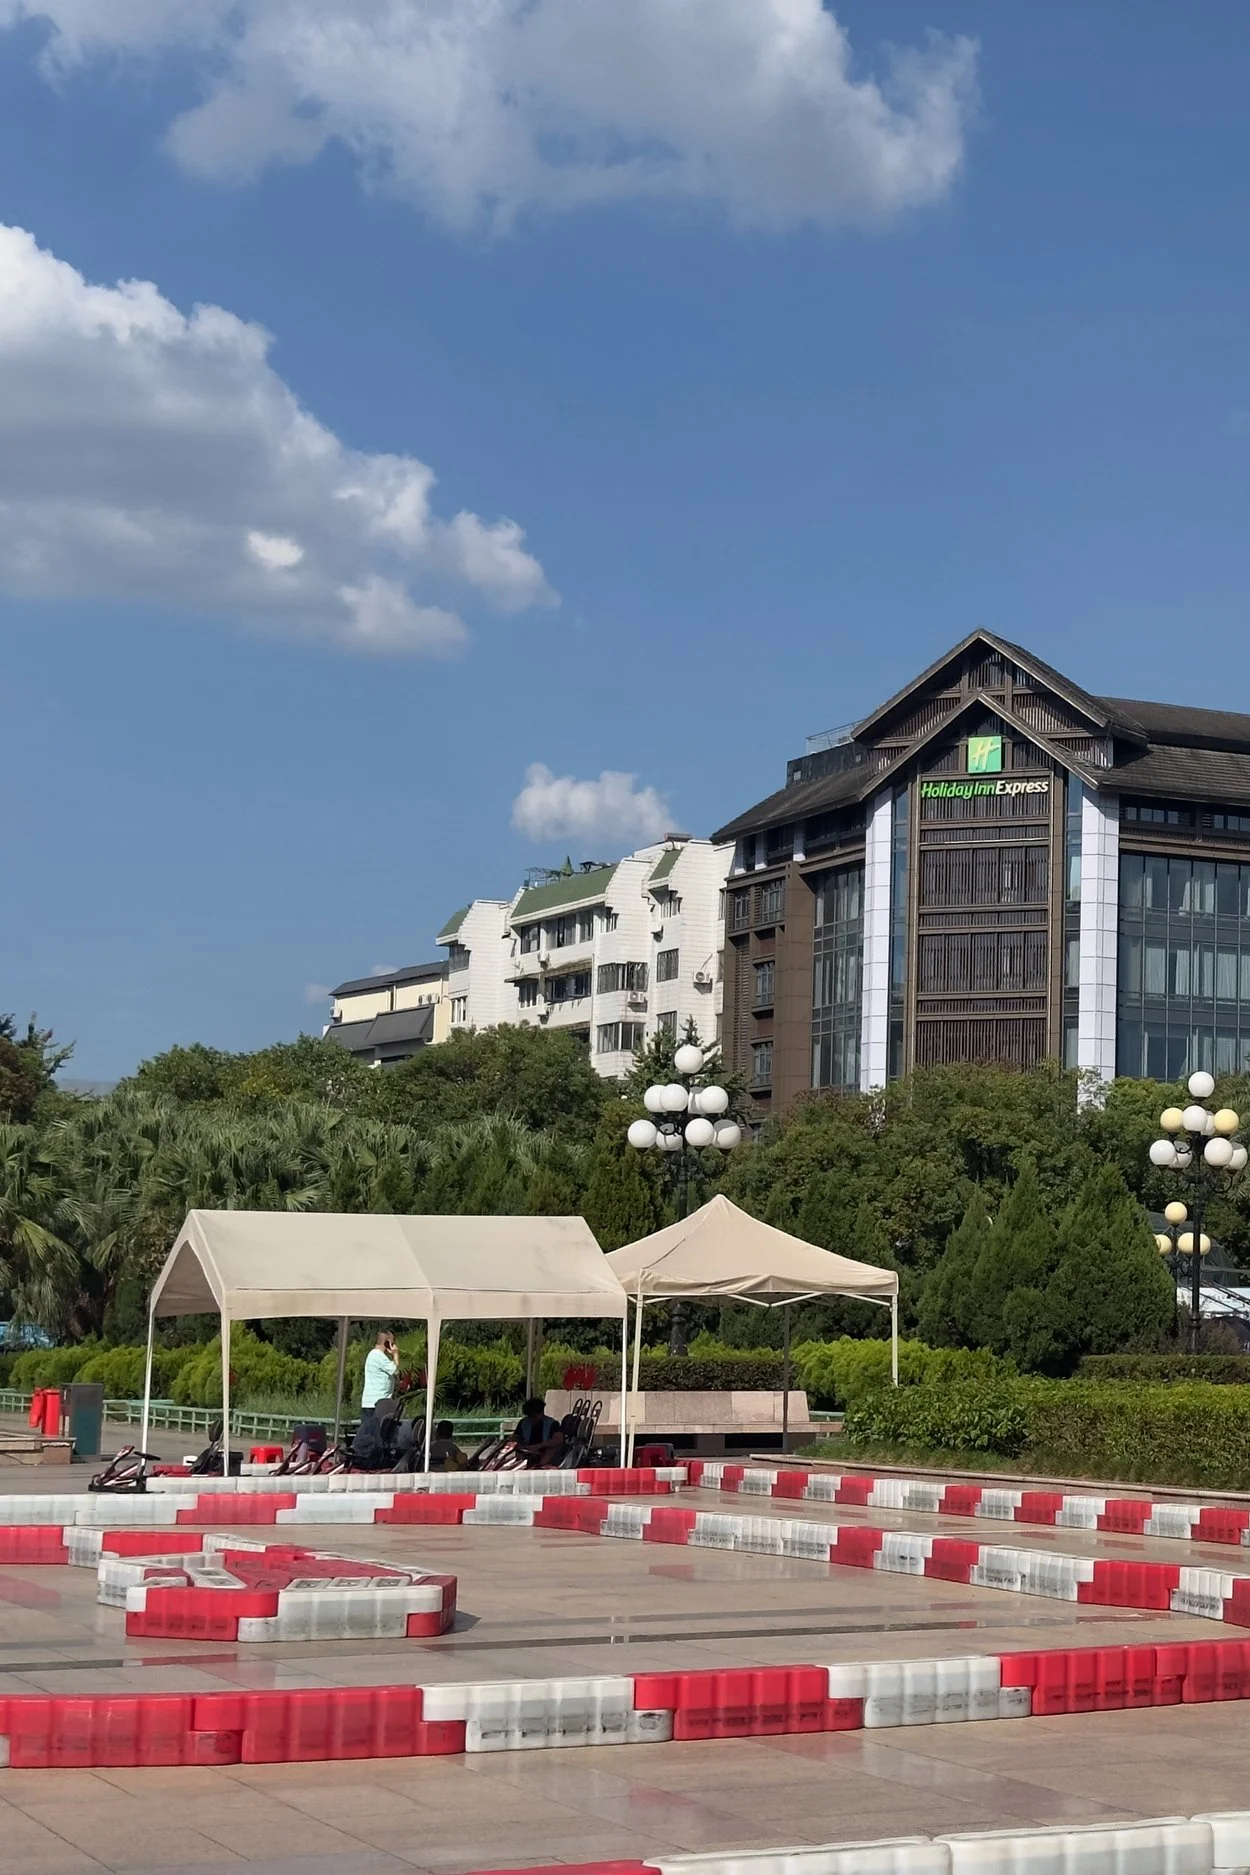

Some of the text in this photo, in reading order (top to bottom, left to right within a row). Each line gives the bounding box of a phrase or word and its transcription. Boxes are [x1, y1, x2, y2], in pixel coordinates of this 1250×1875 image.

[921, 780, 1049, 799] Holiday Inn Express
